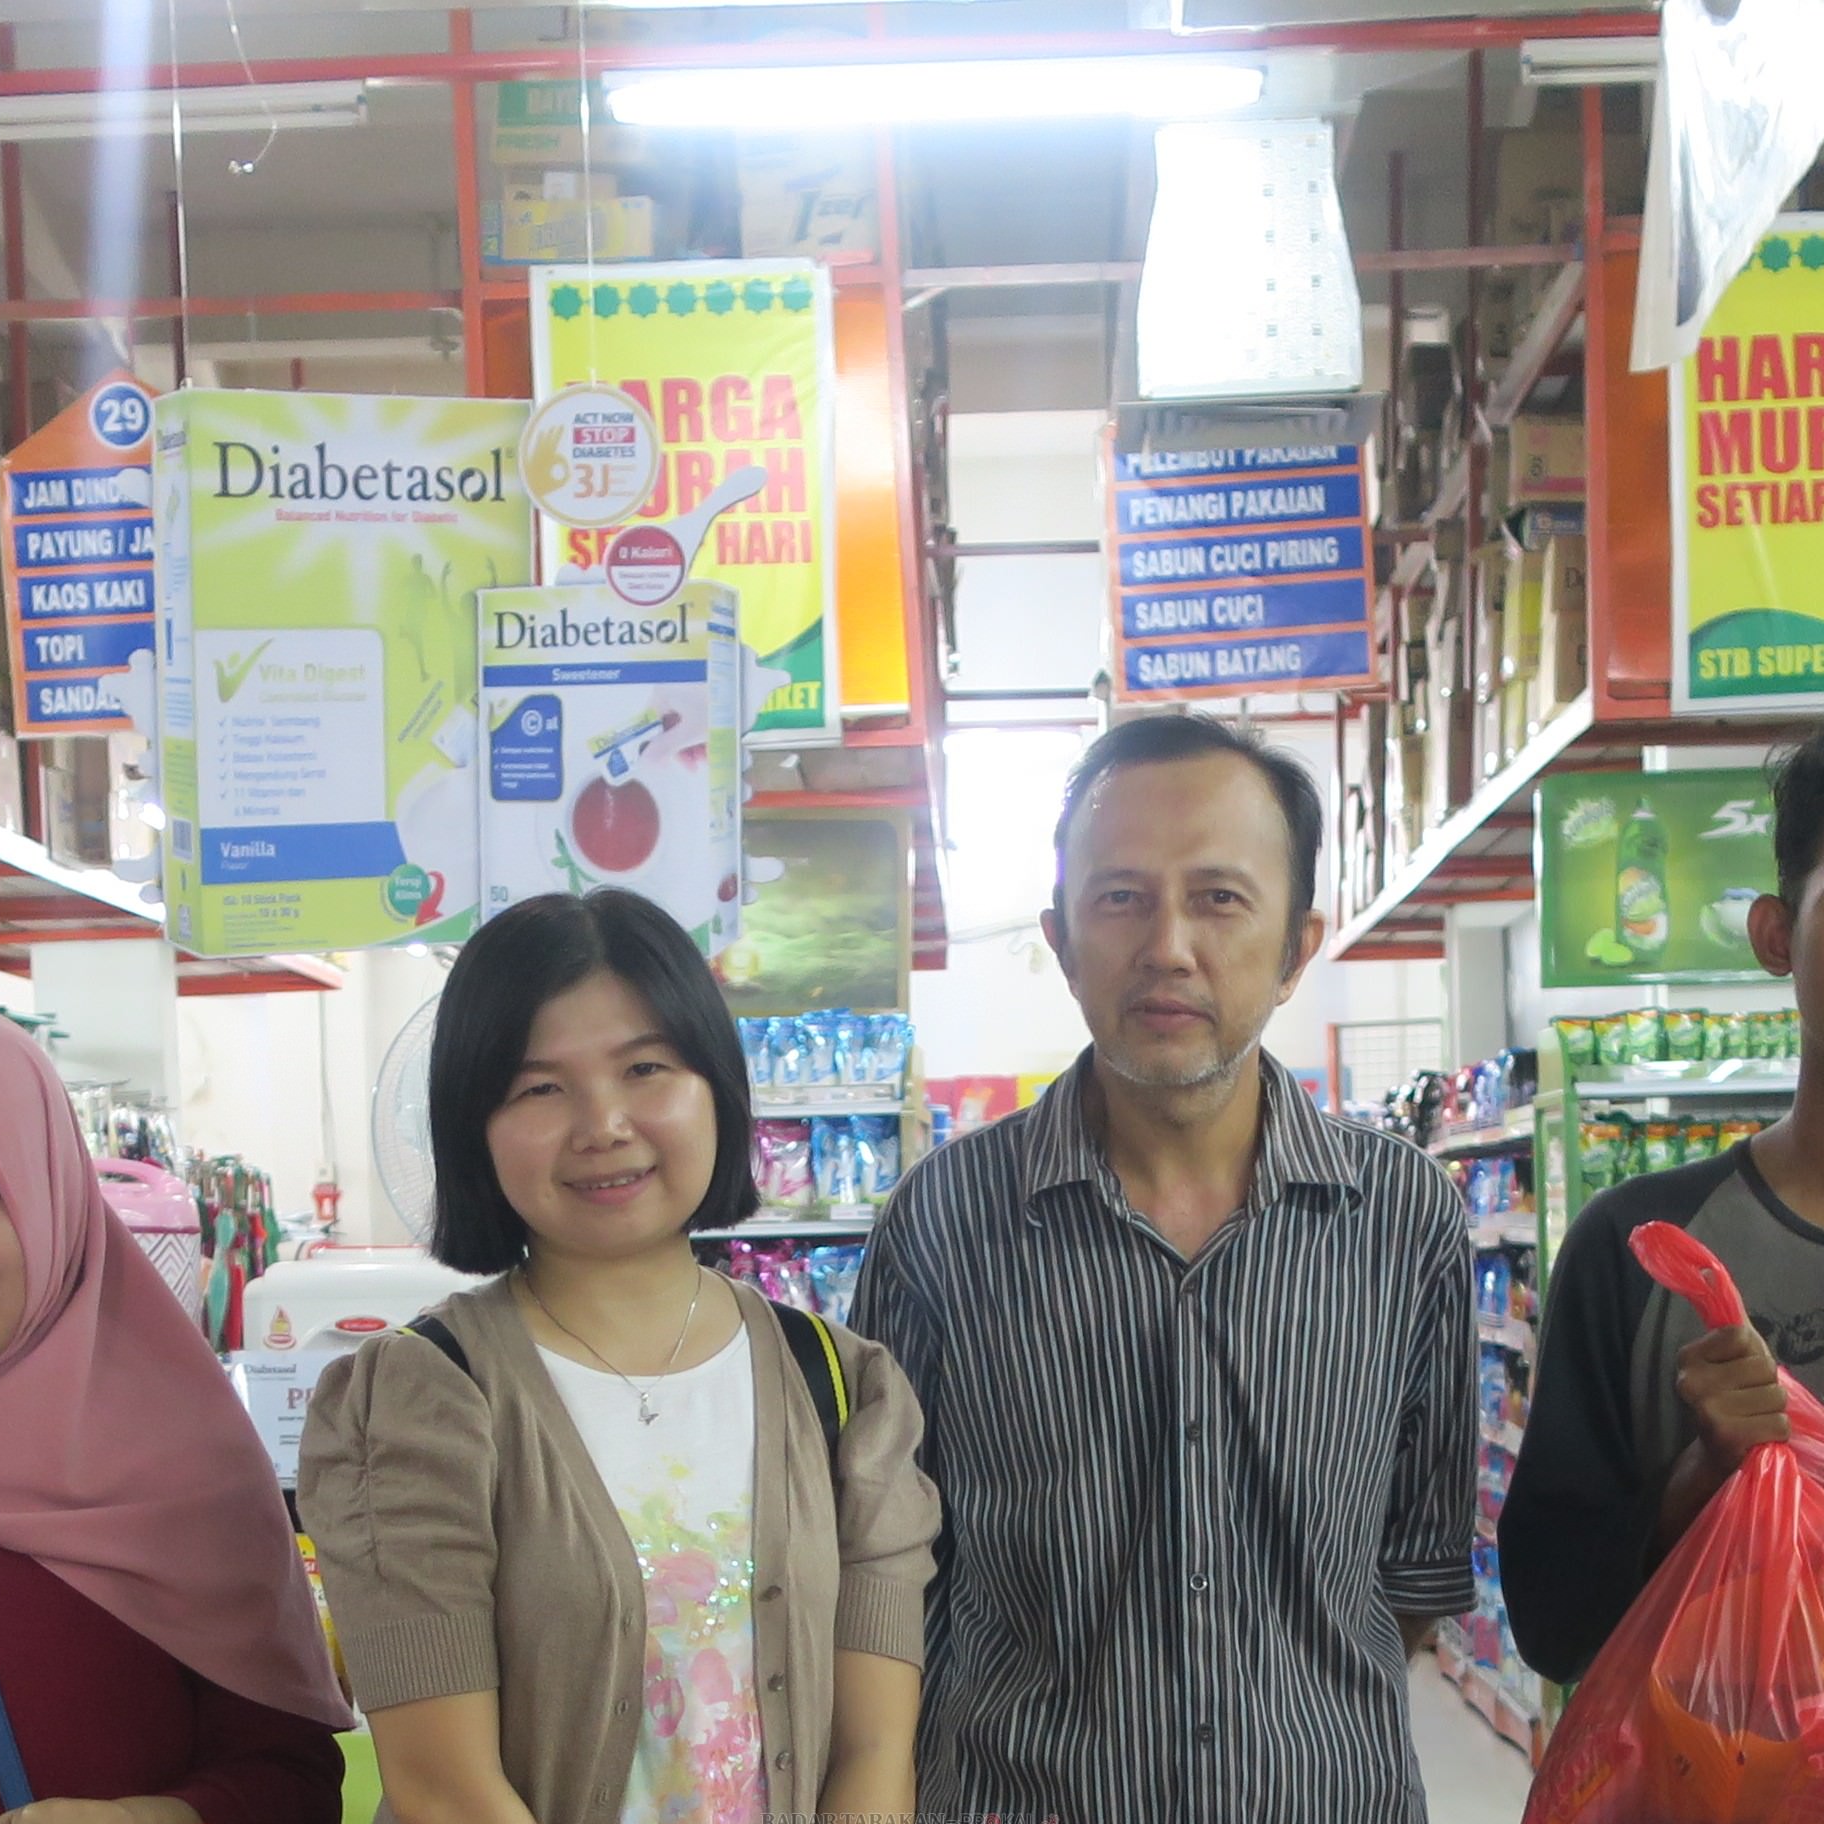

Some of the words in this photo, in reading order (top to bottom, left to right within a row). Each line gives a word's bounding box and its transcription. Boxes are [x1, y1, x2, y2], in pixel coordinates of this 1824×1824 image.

[100, 398, 144, 432] 29
[566, 375, 802, 444] ARGA
[573, 446, 635, 458] DIABETES
[581, 429, 630, 443] STOP
[213, 441, 505, 503] Diabetasol
[25, 479, 67, 509] JAM
[1130, 492, 1225, 526] PEWANGI
[1231, 485, 1325, 517] PAKAIAN
[28, 527, 112, 560] PAYUNG
[716, 519, 812, 565] HARI
[1132, 546, 1205, 578] SABUN
[1210, 543, 1261, 572] CUCI
[1266, 536, 1339, 568] PIRING
[31, 583, 88, 612] KAOS
[94, 579, 145, 608] KAKI
[1135, 598, 1208, 630] SABUN
[1212, 593, 1264, 622] CUCI
[494, 603, 689, 649] Diabetasol
[36, 636, 84, 662] TOPI
[1138, 652, 1211, 682] SABUN
[1216, 644, 1302, 675] BATANG
[1699, 647, 1751, 679] STB
[551, 667, 621, 682] Sweetener
[220, 842, 275, 858] Vanilla
